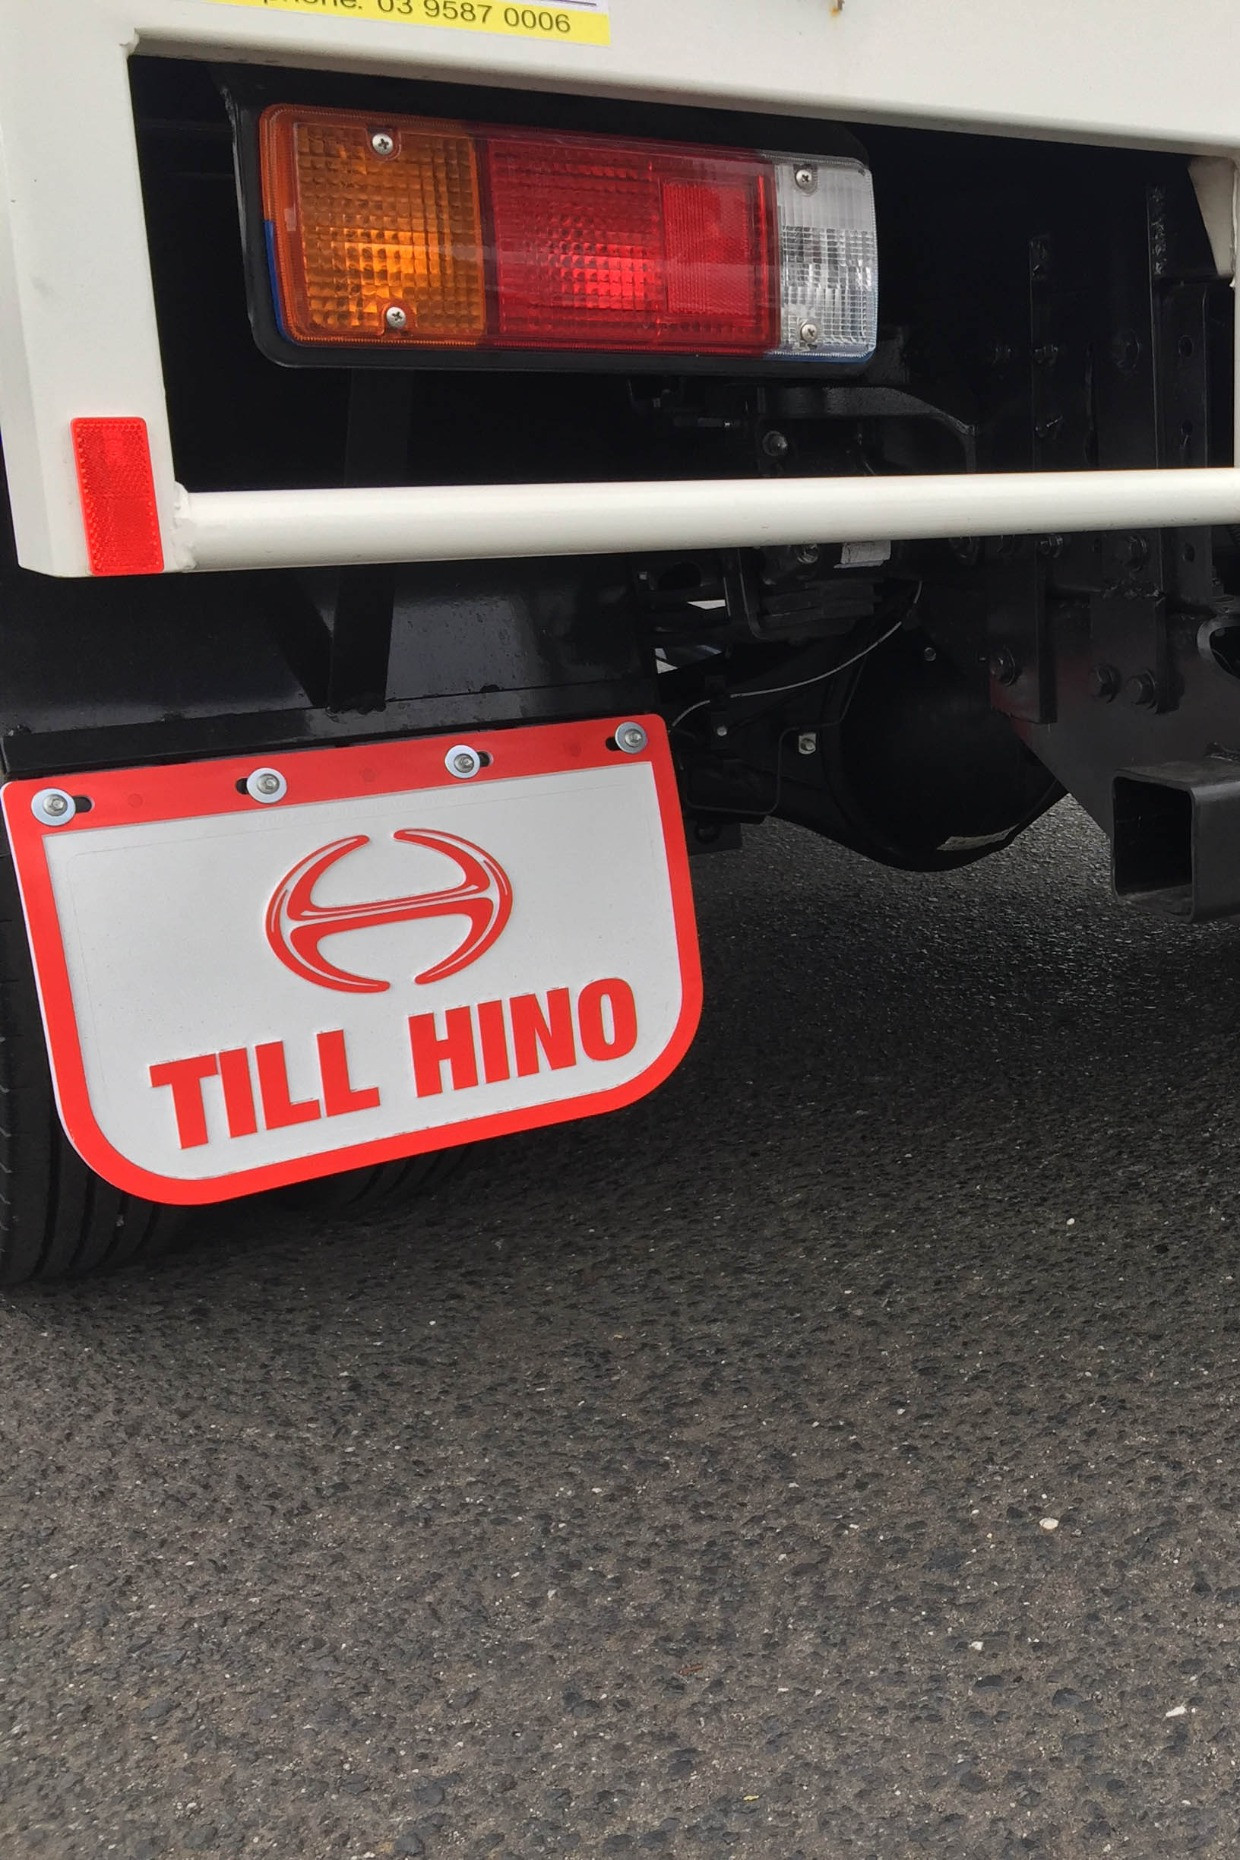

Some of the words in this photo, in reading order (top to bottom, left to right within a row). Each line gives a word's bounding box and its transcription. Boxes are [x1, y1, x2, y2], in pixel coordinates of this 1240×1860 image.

[423, 0, 492, 24] 9587
[503, 7, 571, 33] 0006
[149, 1029, 380, 1149] TILL
[408, 977, 638, 1098] HINO
